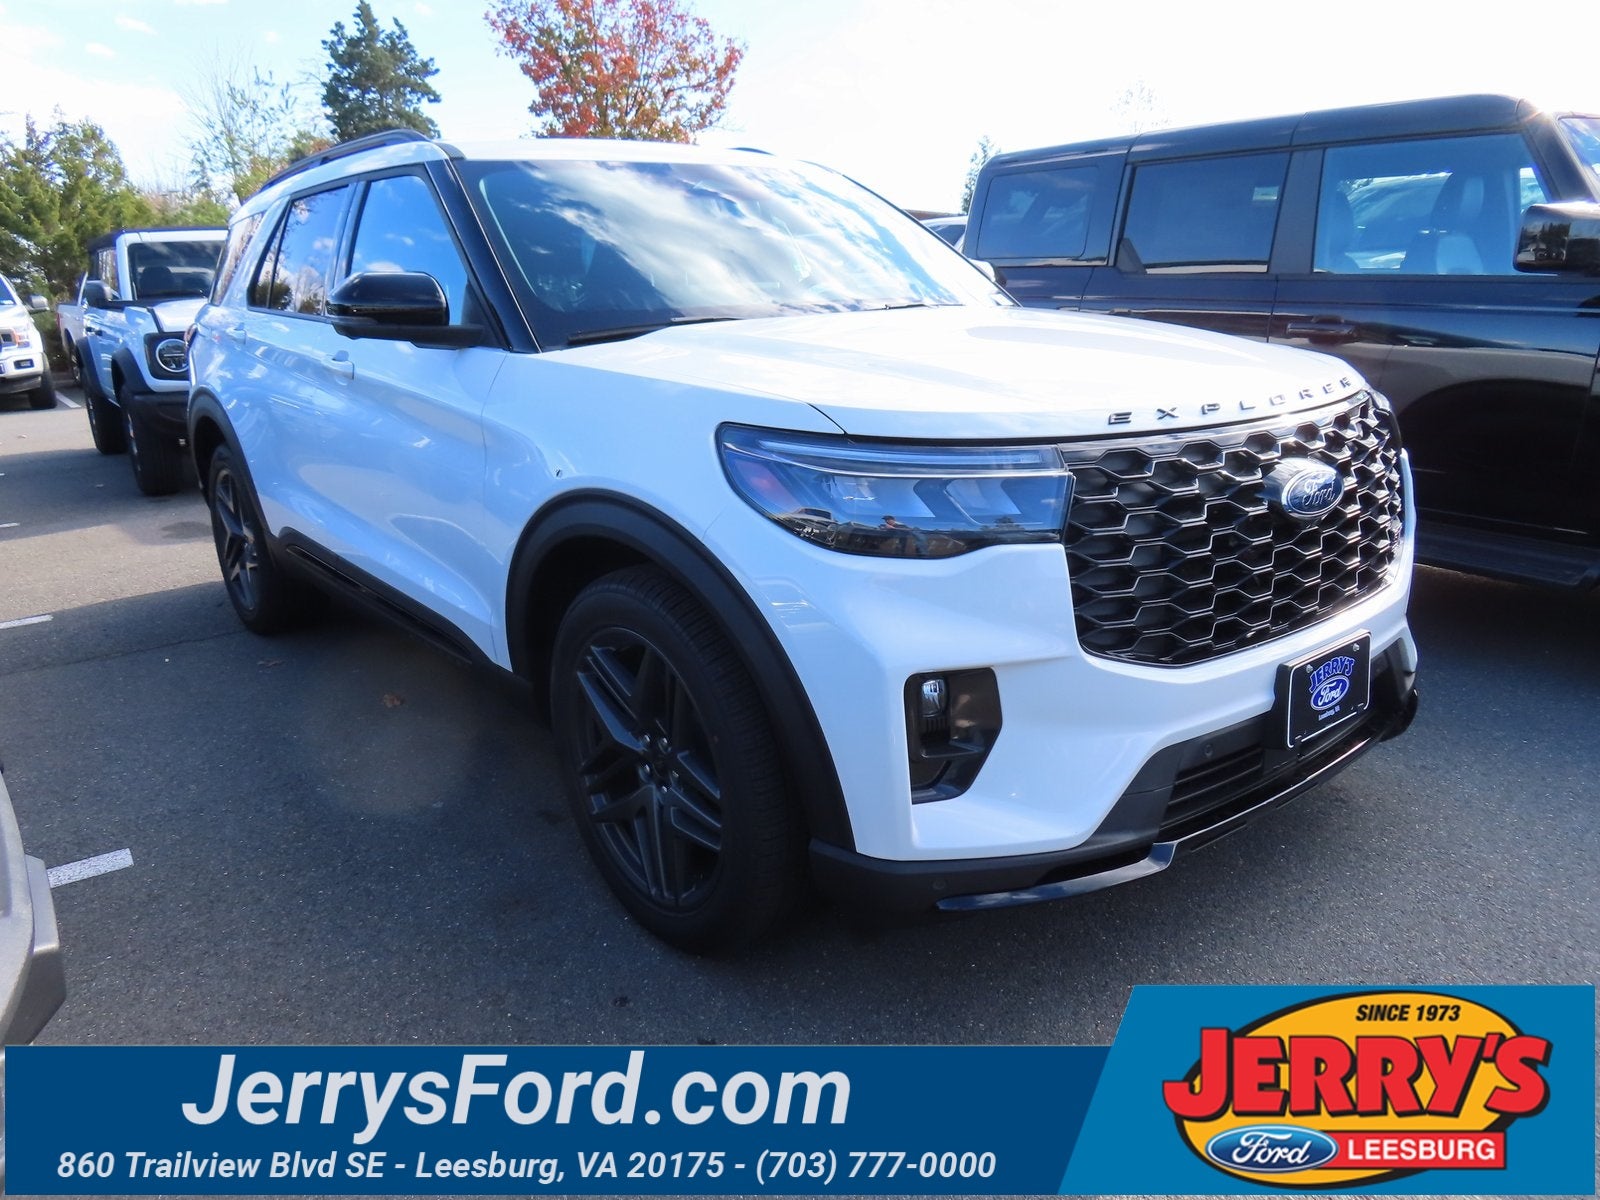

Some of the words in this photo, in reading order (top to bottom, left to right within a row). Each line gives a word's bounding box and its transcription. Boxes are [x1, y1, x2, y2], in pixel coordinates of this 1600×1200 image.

[1108, 376, 1352, 425] EXPLORER
[1301, 475, 1337, 507] Ford
[1308, 656, 1356, 693] JERRY'S
[1317, 681, 1344, 706] Ford
